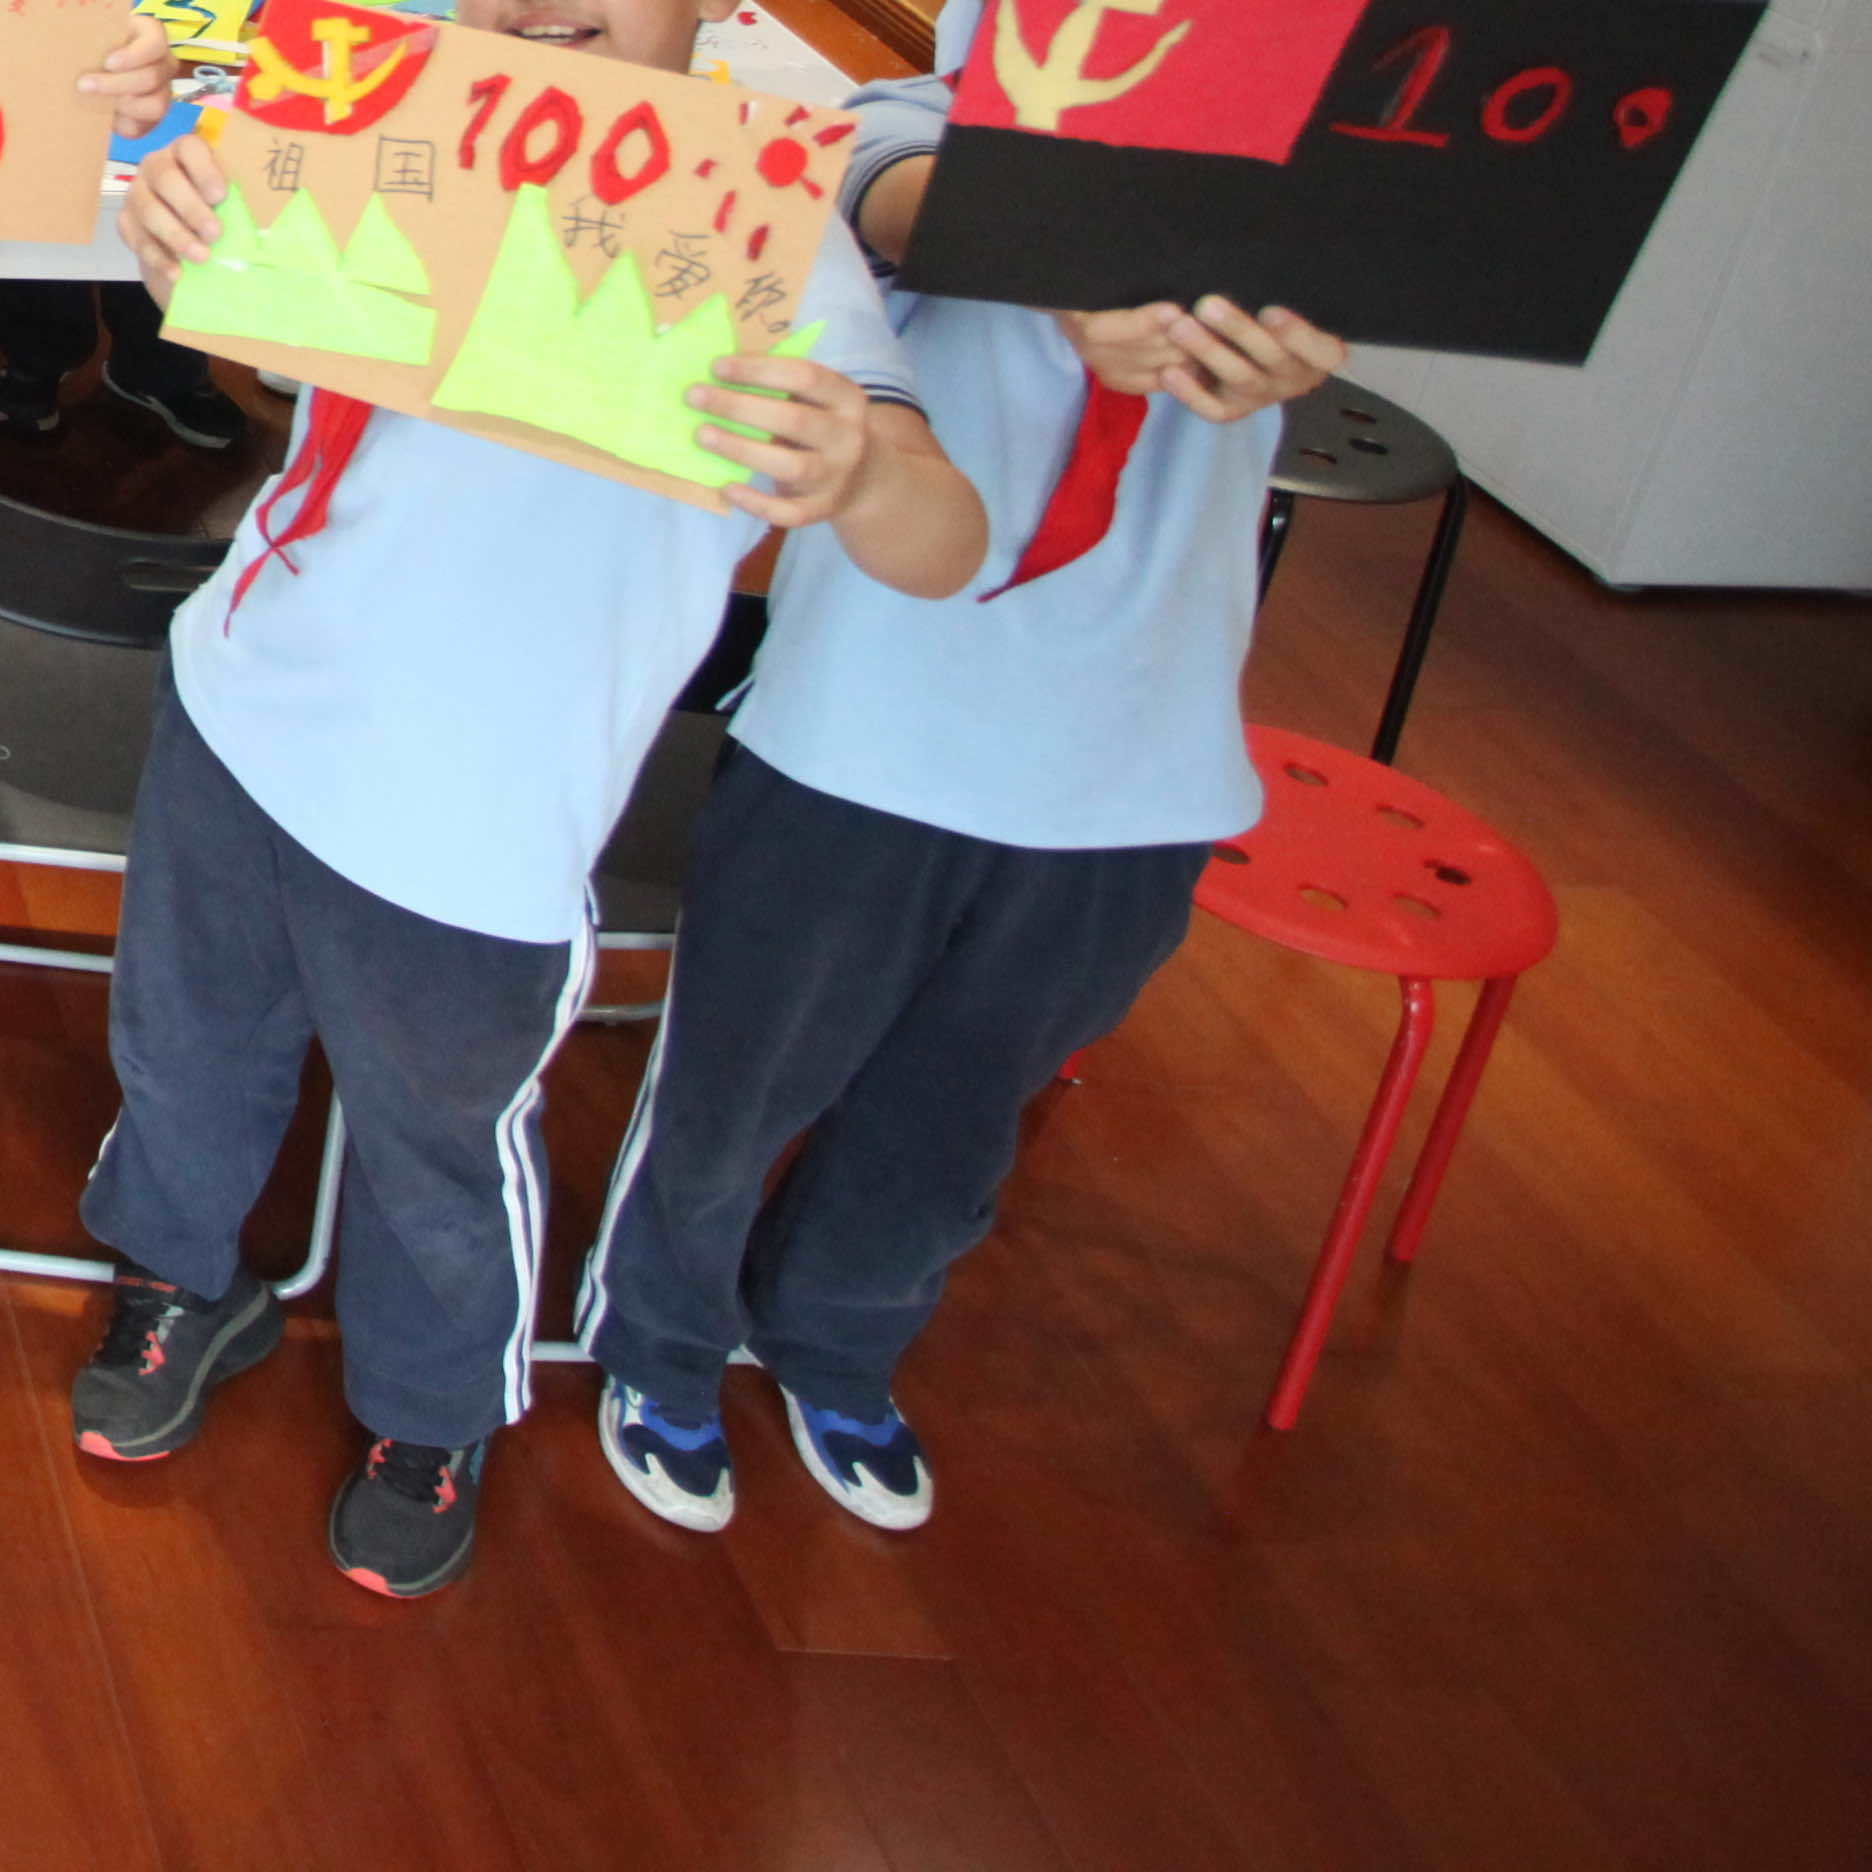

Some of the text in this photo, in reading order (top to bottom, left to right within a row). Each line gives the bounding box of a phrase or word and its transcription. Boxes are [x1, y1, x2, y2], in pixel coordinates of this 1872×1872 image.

[457, 71, 672, 206] 100
[1329, 26, 1674, 150] 100
[261, 134, 436, 201] 祖国
